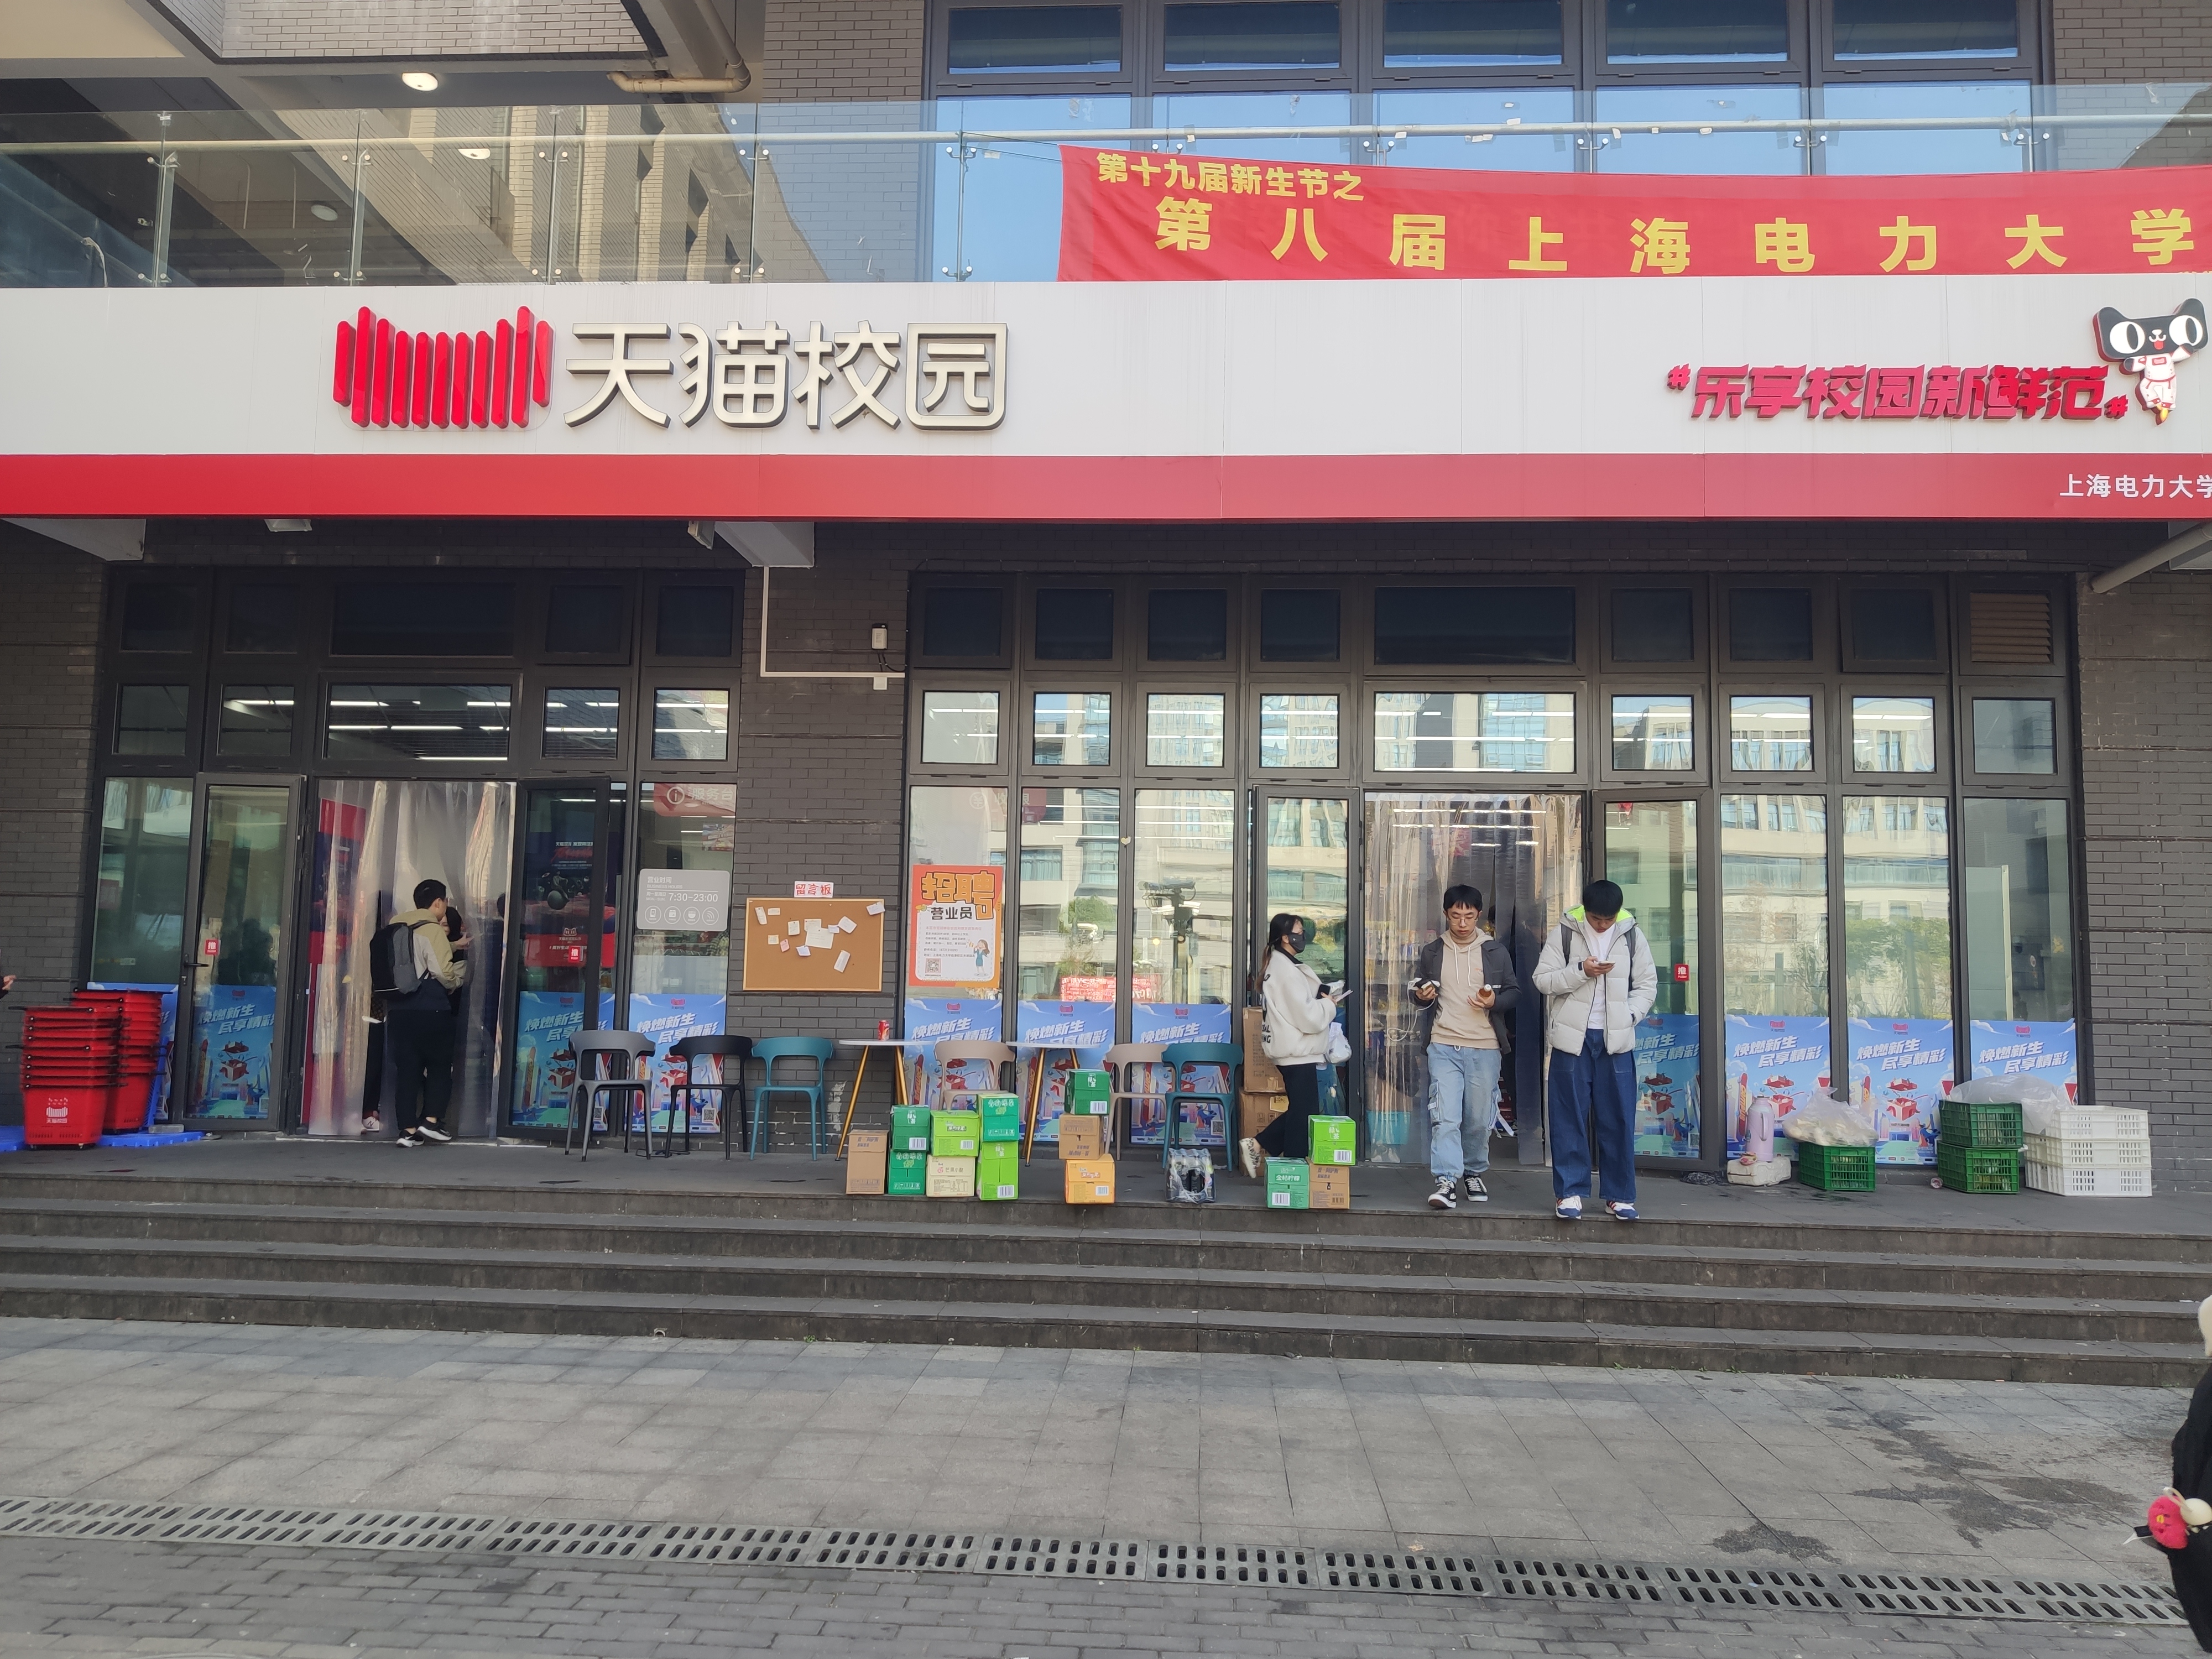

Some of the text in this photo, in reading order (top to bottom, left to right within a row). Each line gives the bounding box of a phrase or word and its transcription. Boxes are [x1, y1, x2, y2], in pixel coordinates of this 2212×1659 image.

[1096, 152, 1365, 201] 第十九届新生节之
[1154, 196, 2194, 273] 第八届上海电力大学
[563, 319, 1009, 430] 天猫校园
[691, 787, 733, 800] 服务台
[795, 883, 832, 895] 留言板
[921, 870, 995, 920] 招聘
[931, 906, 973, 920] 营业员
[207, 941, 217, 950] 推
[571, 948, 579, 957] 推
[1677, 966, 1687, 975] 推
[218, 1014, 275, 1035] 尽享精彩
[524, 1011, 584, 1032] 焕燃新生
[637, 1013, 697, 1034] 焕燃新生
[657, 1021, 719, 1044] 尽享精彩
[911, 1017, 974, 1040] 焕燃新生
[1024, 1020, 1086, 1044] 焕燃新生
[1139, 1022, 1202, 1044] 焕燃新生
[1637, 1043, 1700, 1066] 尽享精彩
[1733, 1035, 1799, 1057] 焕燃新生
[1757, 1045, 1824, 1068] 尽享精彩
[1856, 1038, 1922, 1061] 焕燃新生
[1978, 1041, 2046, 1064] 焕燃新生
[1881, 1047, 1947, 1072] 尽享精彩
[2004, 1051, 2070, 1075] 尽享精彩
[1328, 1126, 1340, 1140] 绿茶
